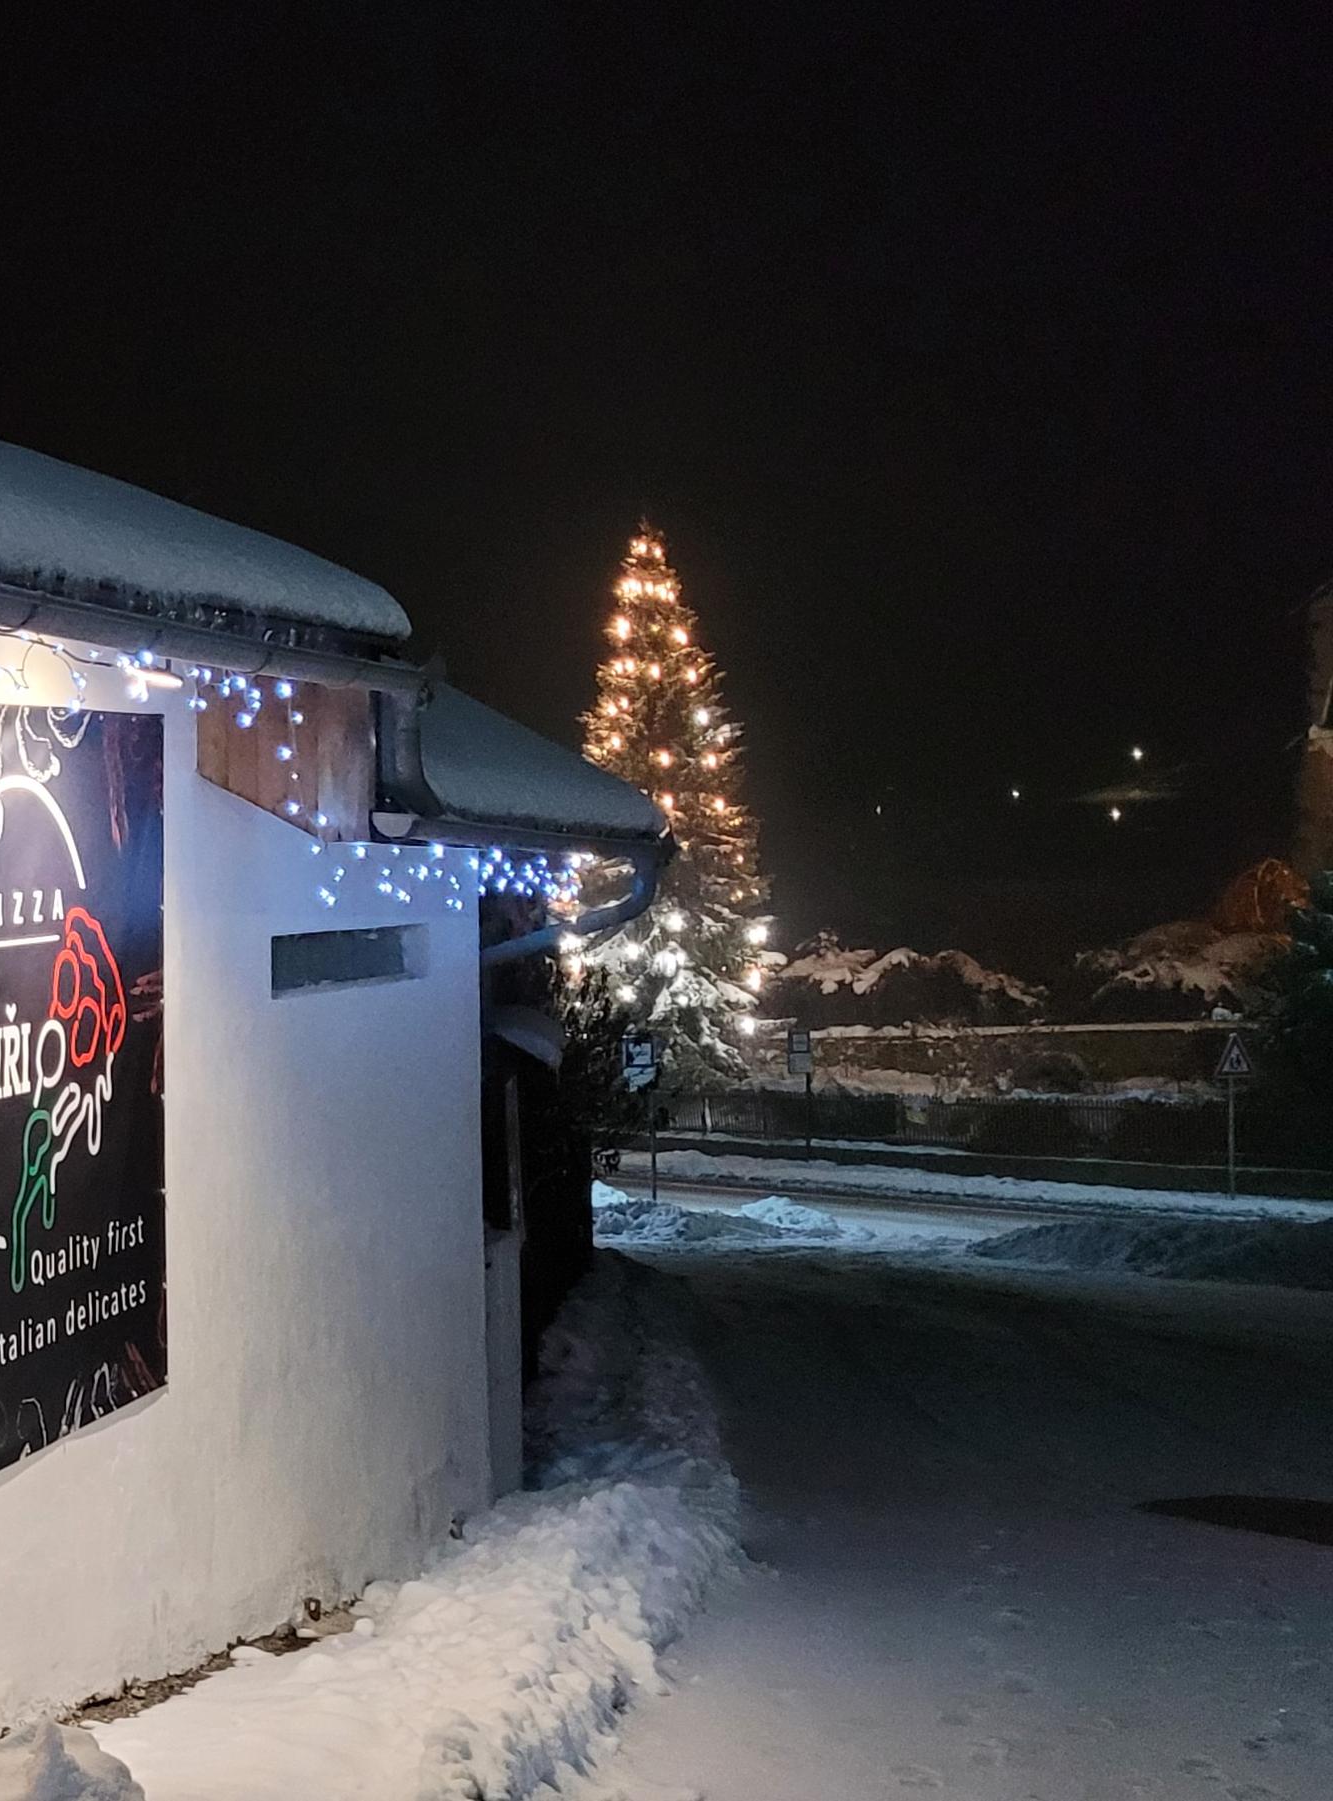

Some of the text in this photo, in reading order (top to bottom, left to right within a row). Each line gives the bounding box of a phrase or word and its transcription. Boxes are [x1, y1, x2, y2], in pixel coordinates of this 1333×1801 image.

[31, 1215, 145, 1287] Quality first
[65, 1279, 147, 1337] delicates
